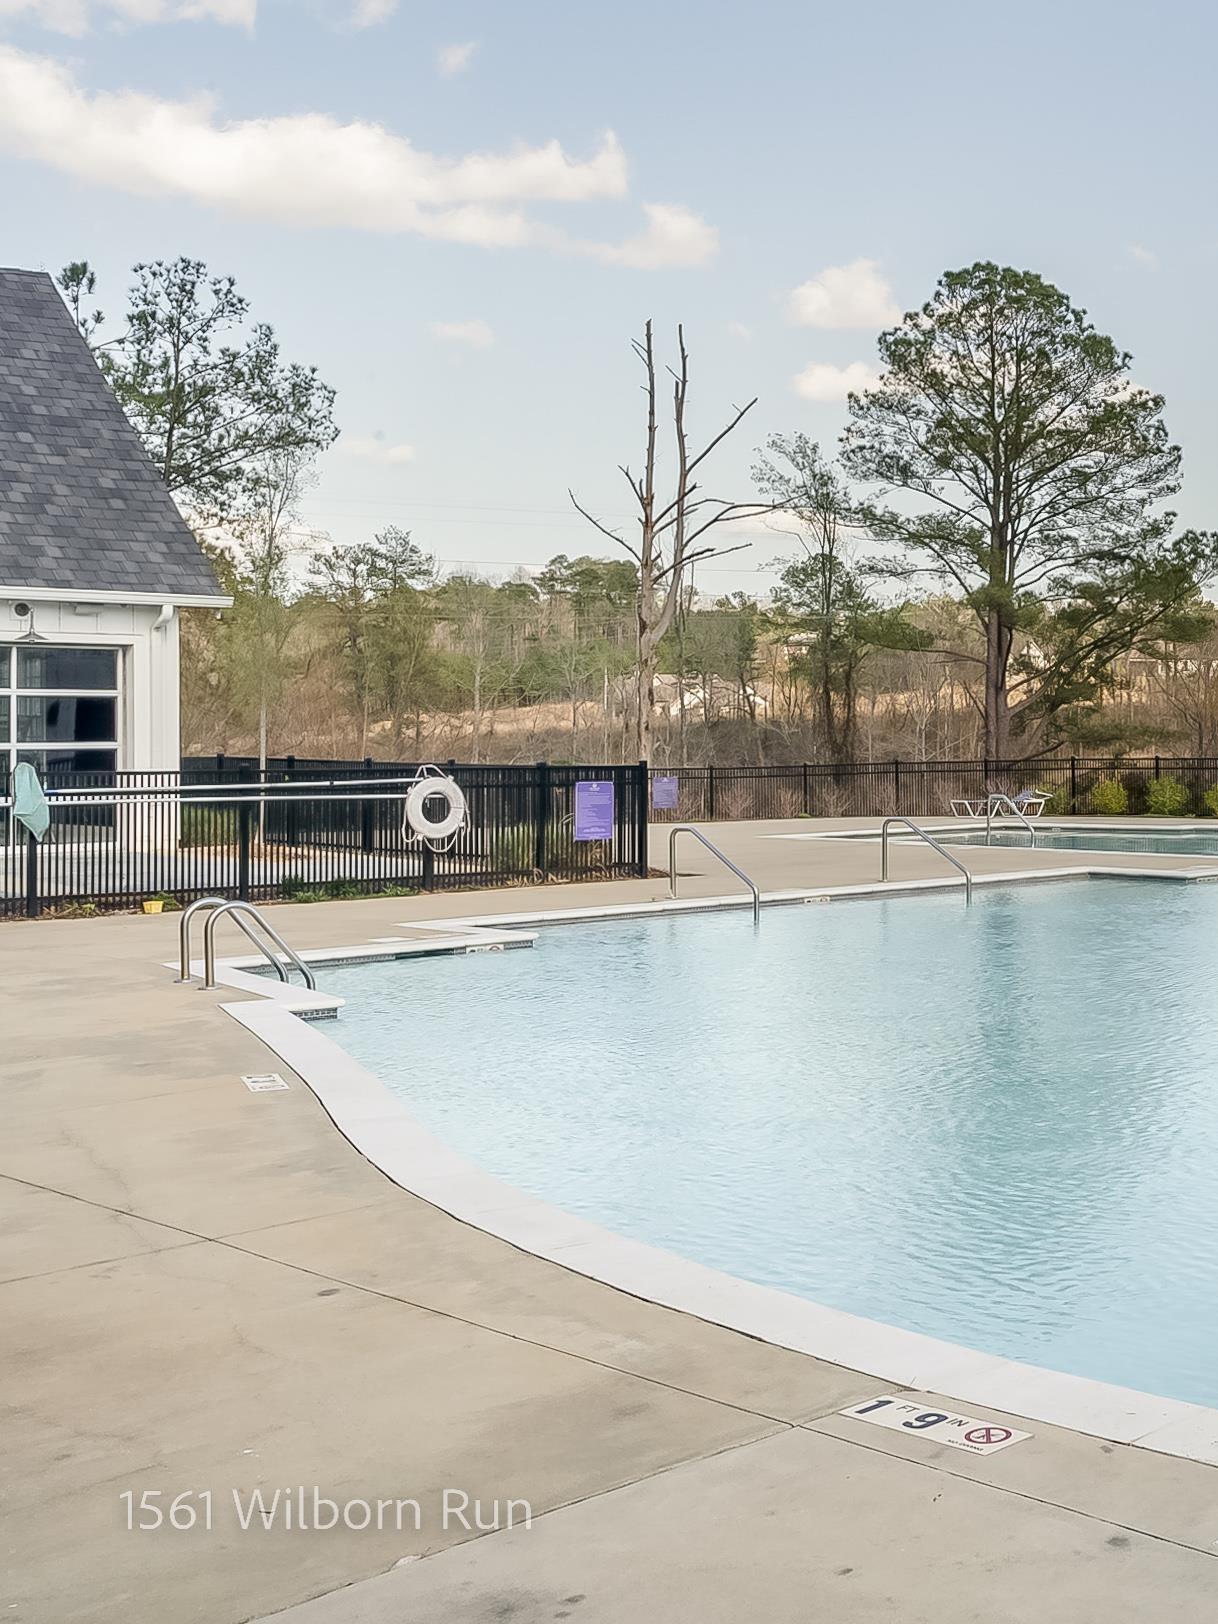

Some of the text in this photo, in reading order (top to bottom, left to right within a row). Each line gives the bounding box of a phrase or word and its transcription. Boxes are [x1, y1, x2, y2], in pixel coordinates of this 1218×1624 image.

[854, 1400, 970, 1429] 1 FT 9 IN
